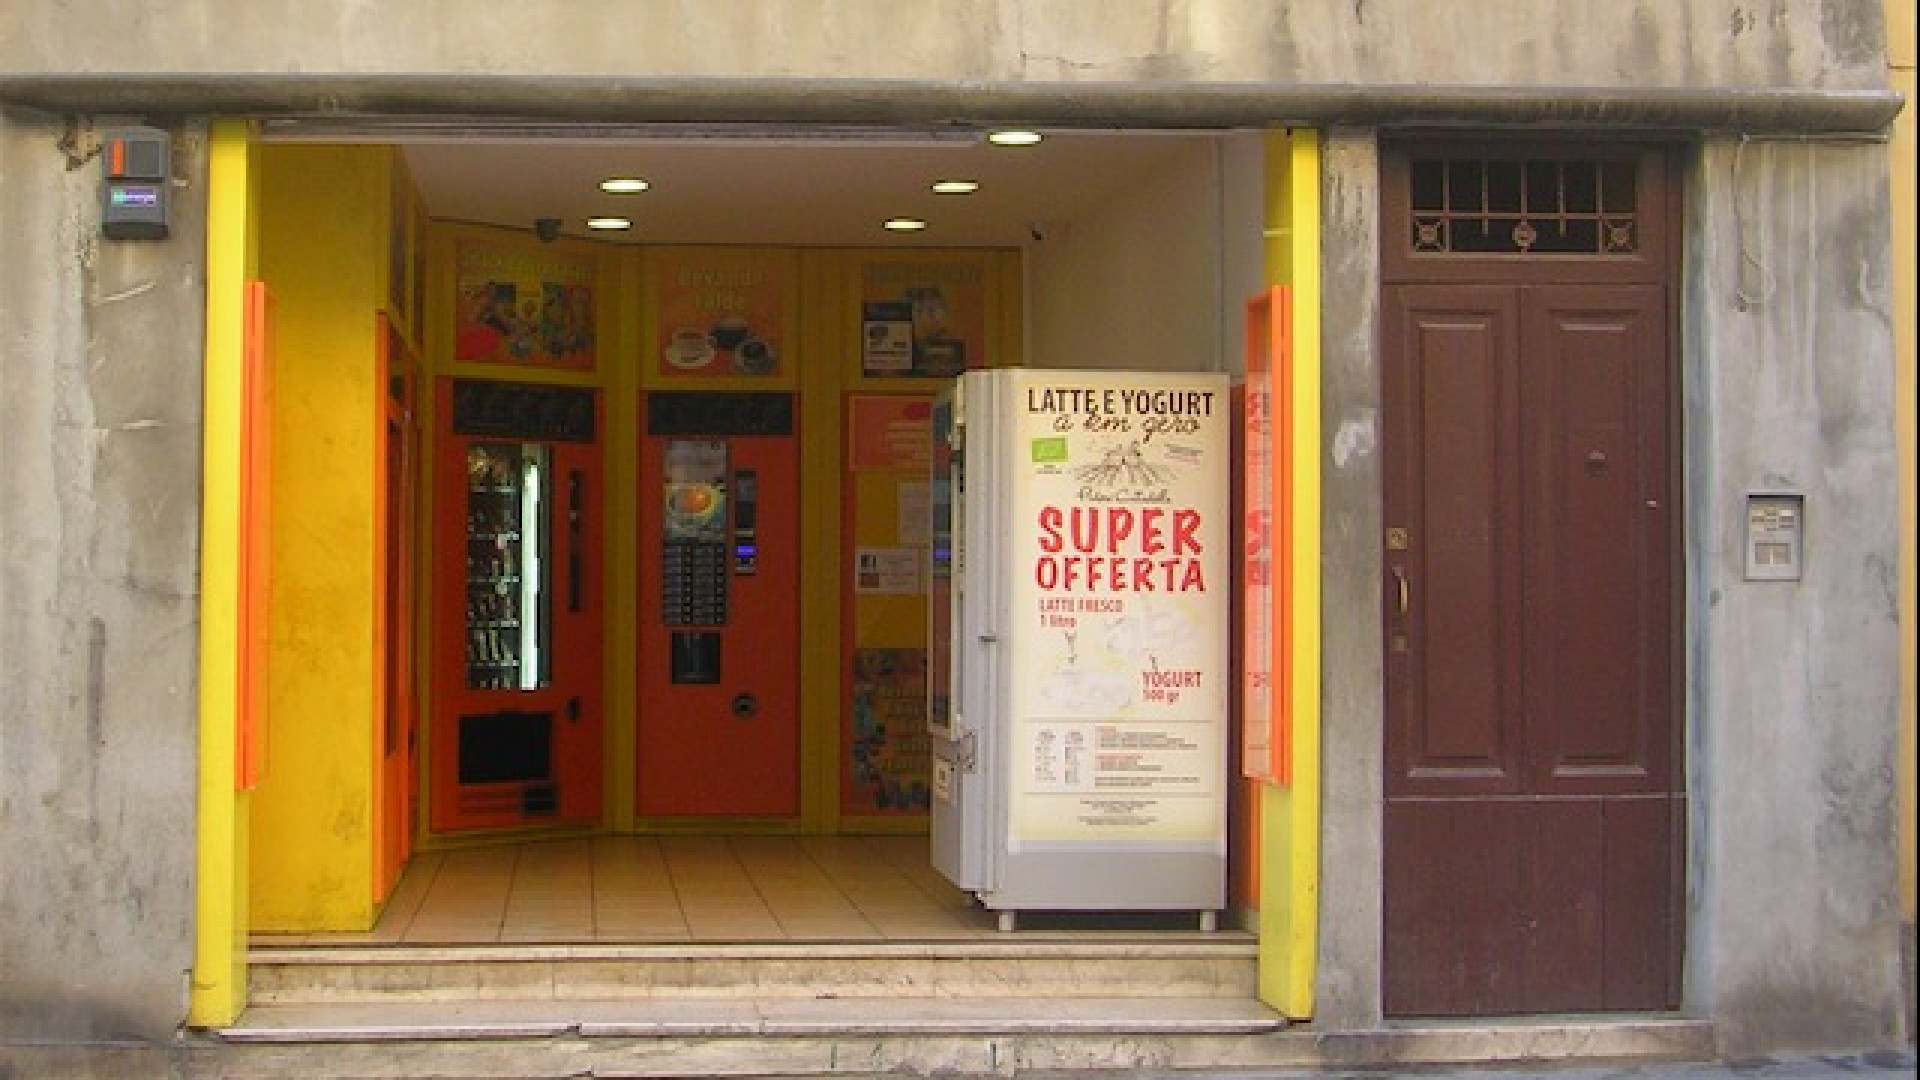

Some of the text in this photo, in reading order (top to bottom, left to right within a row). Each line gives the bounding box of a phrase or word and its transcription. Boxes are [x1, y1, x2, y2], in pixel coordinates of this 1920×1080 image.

[1028, 388, 1215, 417] LATTE E YOGURT
[1037, 505, 1204, 555] SUPER
[1035, 557, 1206, 592] OFFERTA
[1038, 599, 1124, 613] LATTE FRESCO
[1142, 671, 1203, 688] YOGURT
